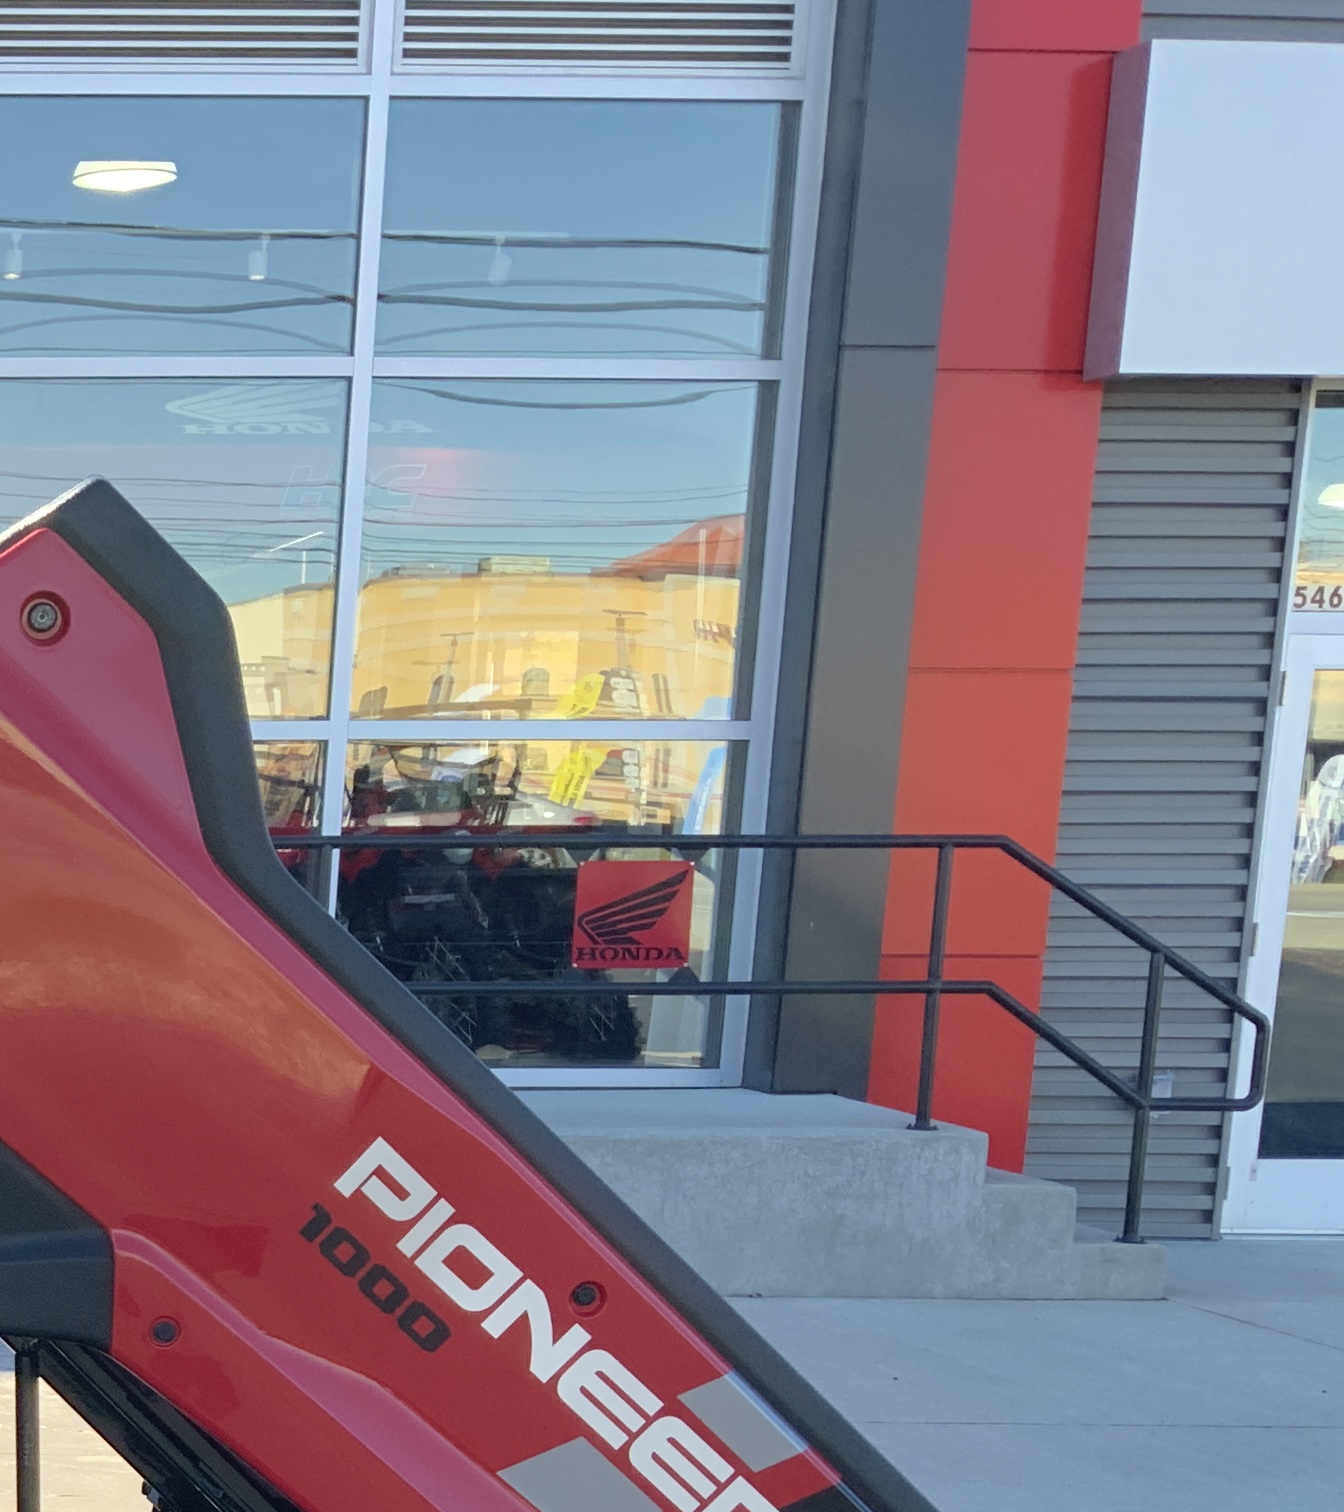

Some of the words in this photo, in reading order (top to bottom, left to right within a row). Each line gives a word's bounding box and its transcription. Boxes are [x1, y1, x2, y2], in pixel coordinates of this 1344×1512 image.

[281, 464, 427, 508] HC
[1293, 586, 1343, 608] 546
[575, 947, 686, 961] HONDA
[300, 1204, 452, 1353] 1000
